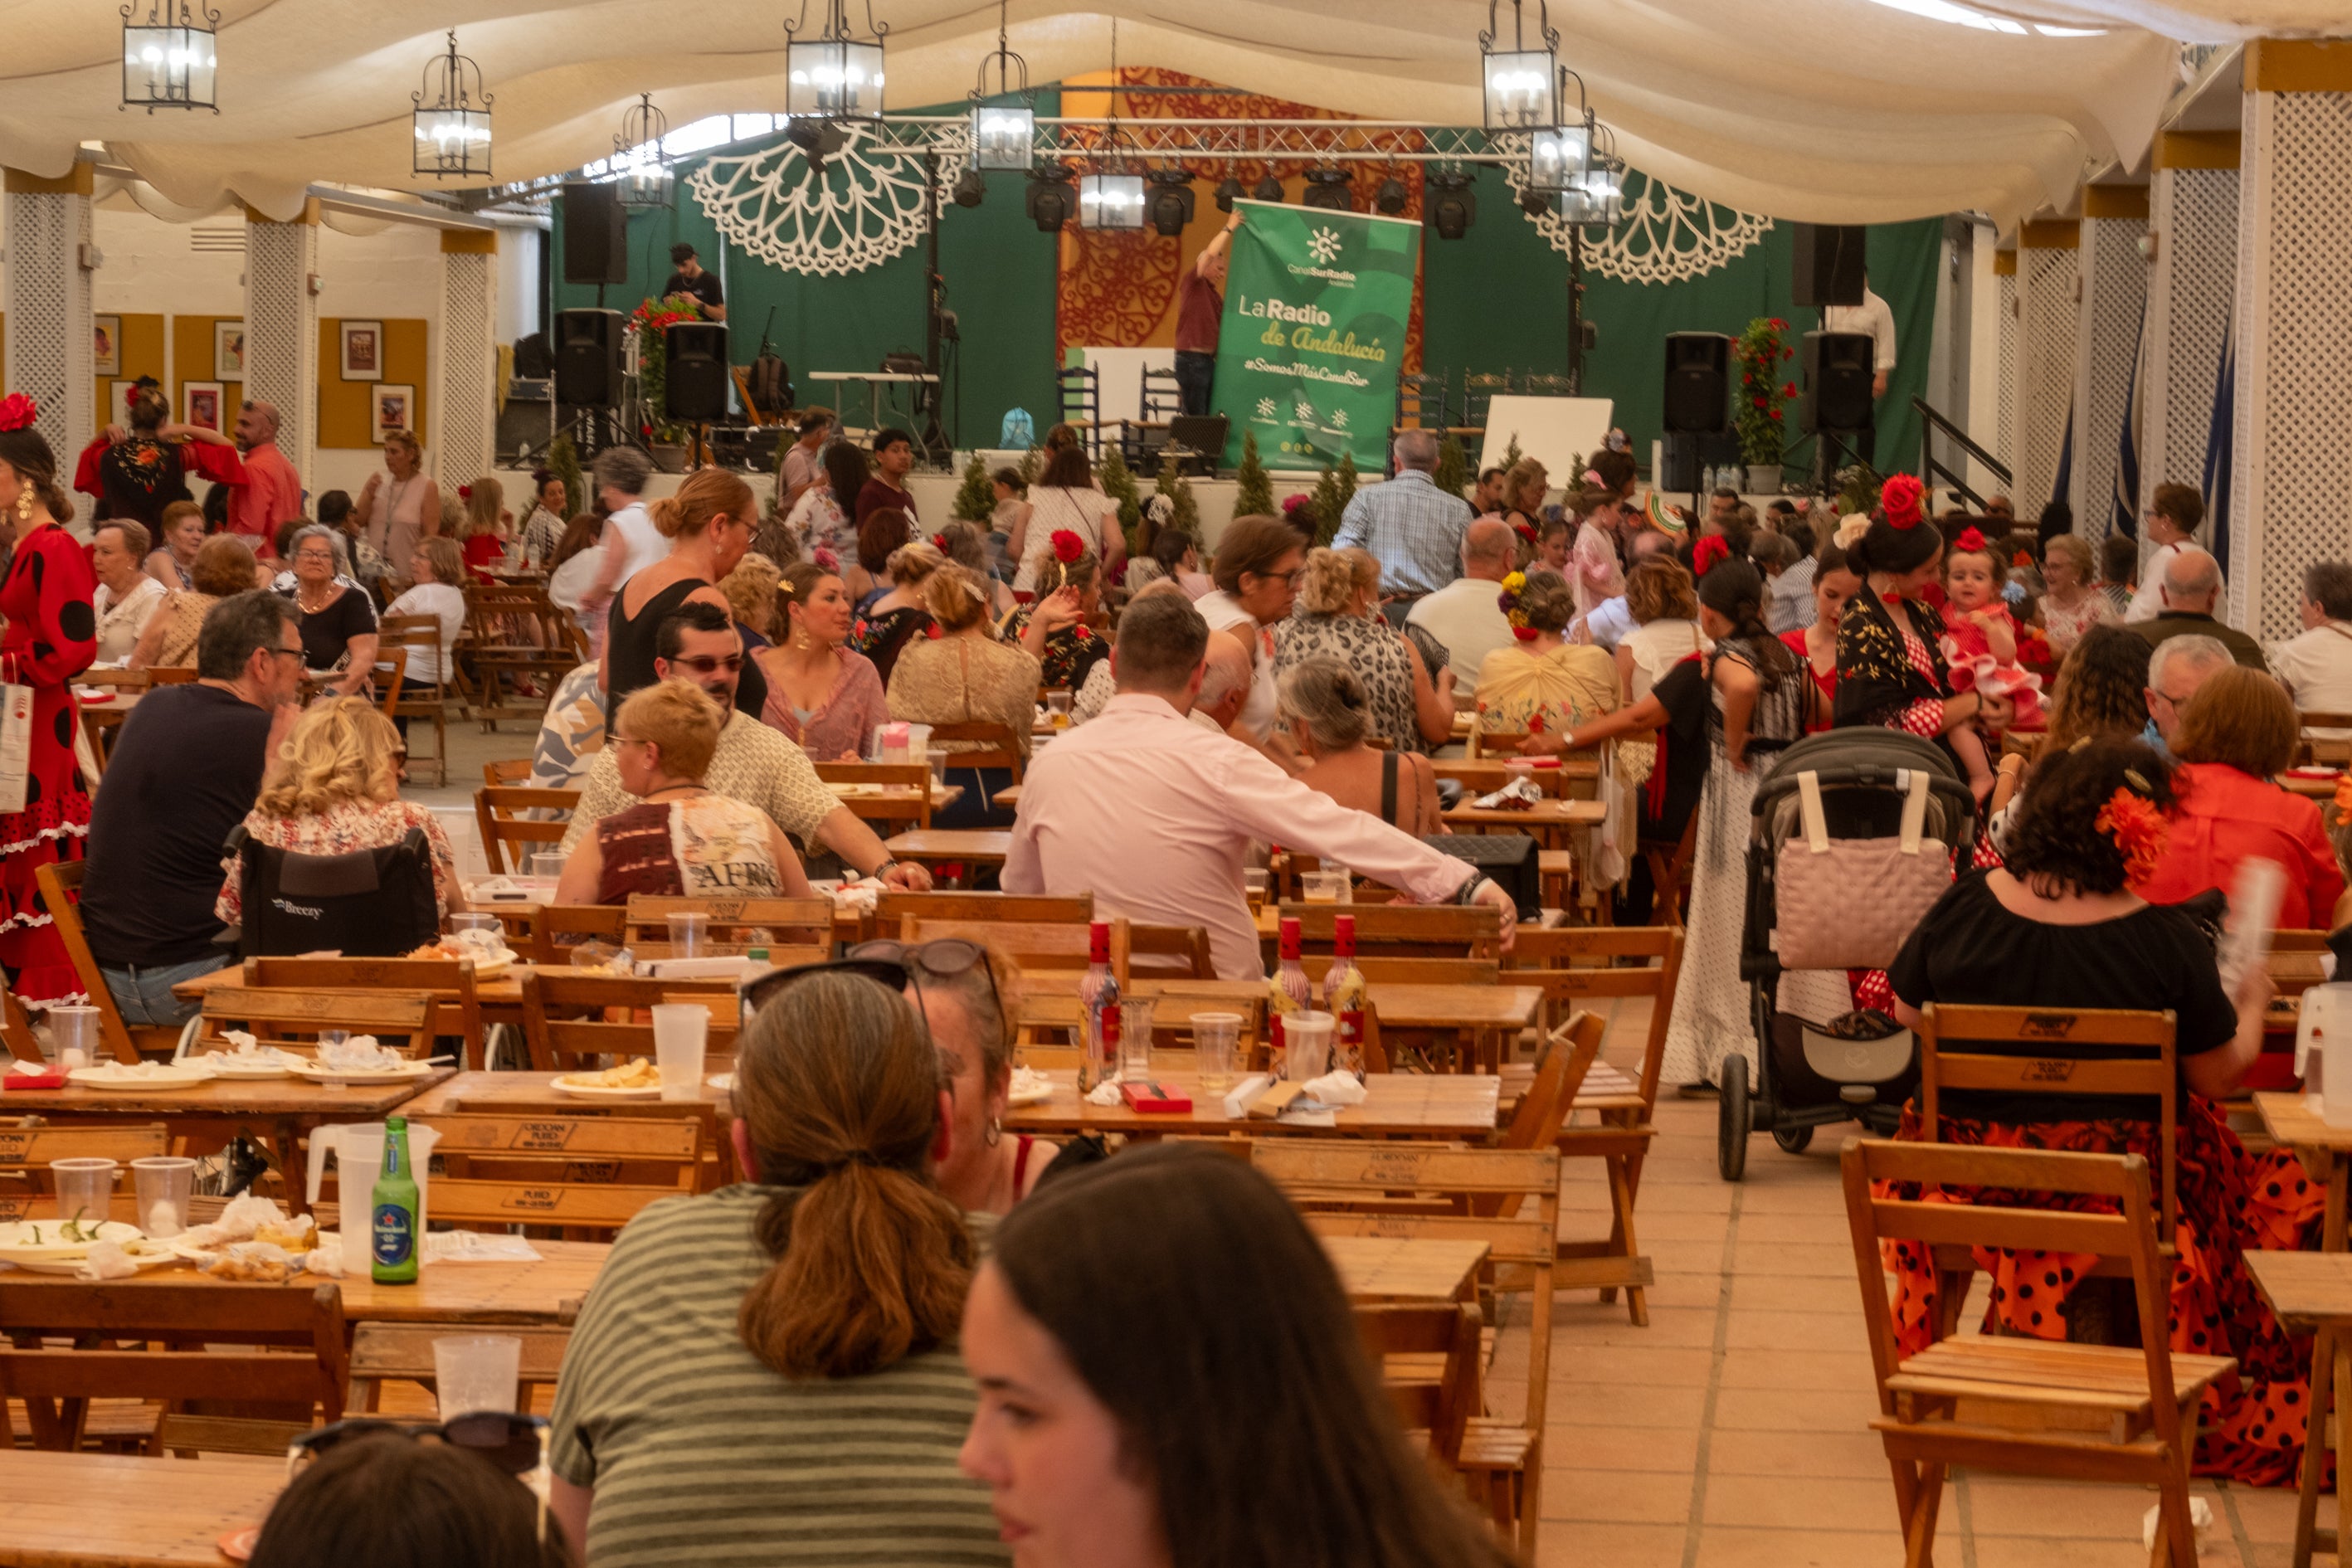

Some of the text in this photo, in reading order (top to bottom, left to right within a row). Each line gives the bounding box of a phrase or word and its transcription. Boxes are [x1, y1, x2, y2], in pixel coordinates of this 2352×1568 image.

[1261, 320, 1386, 363] de Andalucía
[285, 900, 320, 921] Breezy
